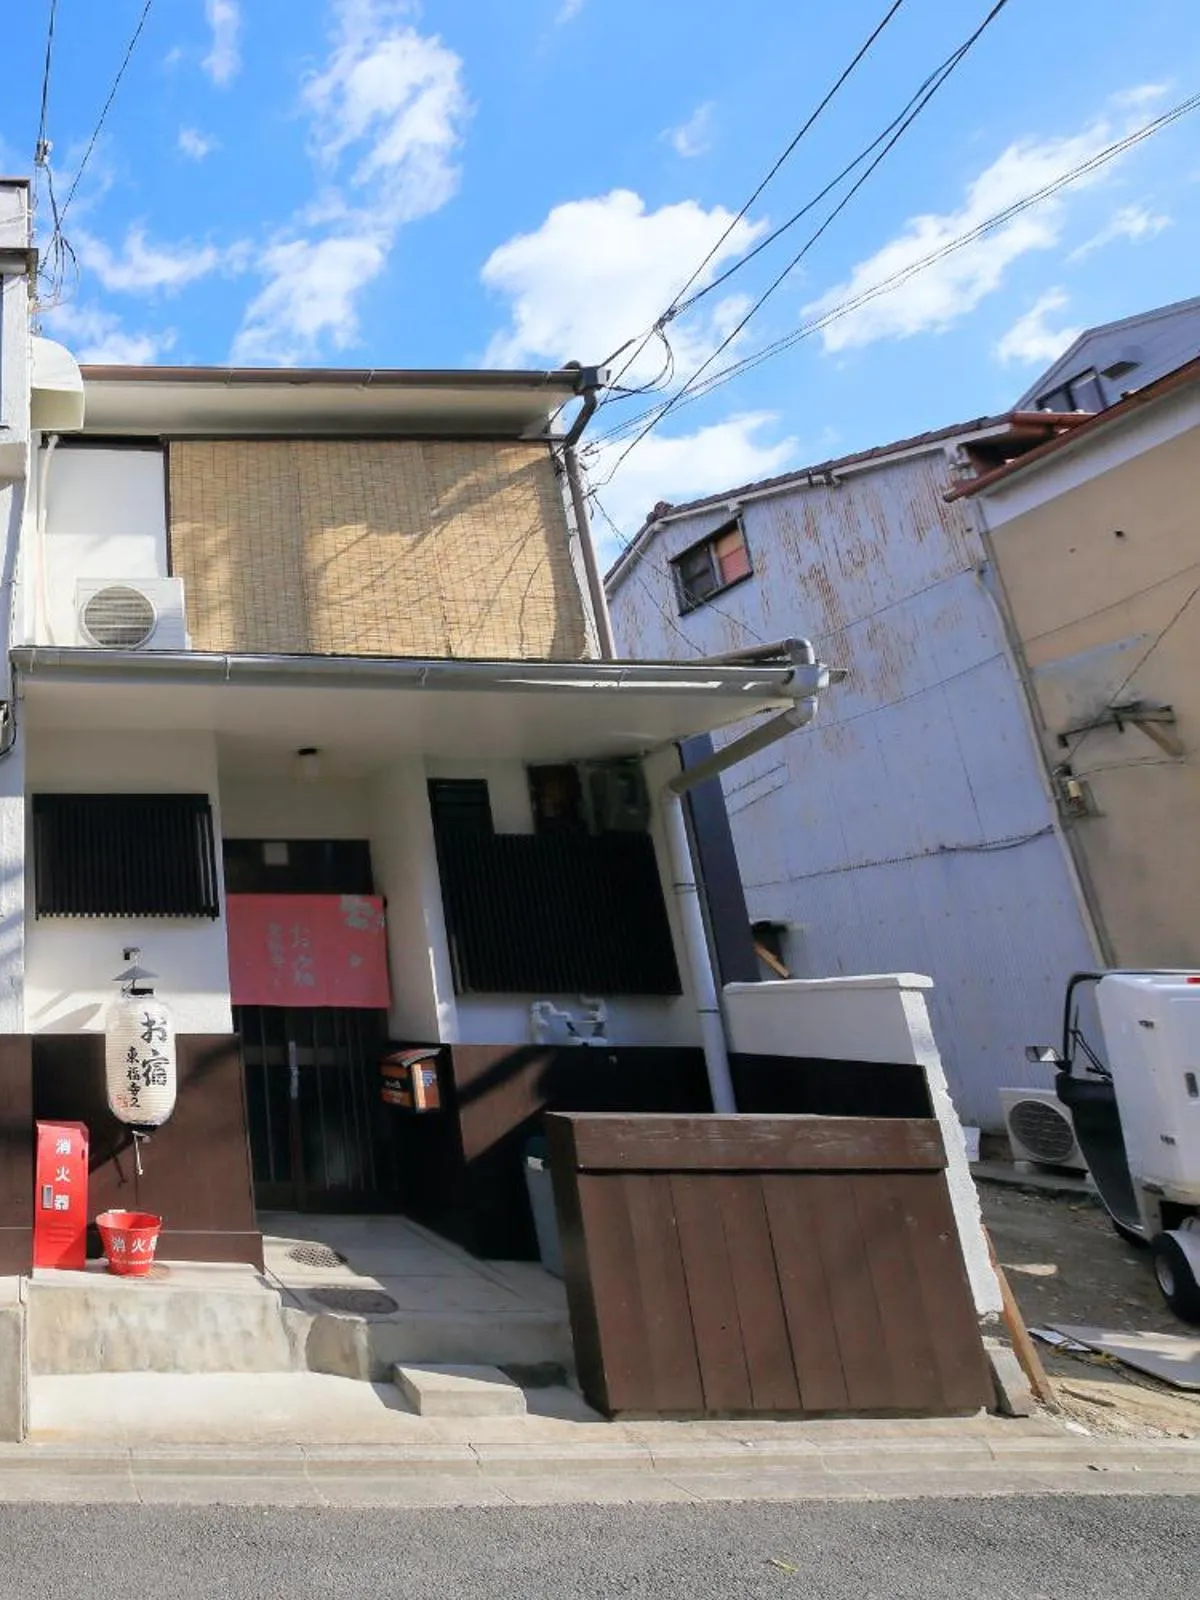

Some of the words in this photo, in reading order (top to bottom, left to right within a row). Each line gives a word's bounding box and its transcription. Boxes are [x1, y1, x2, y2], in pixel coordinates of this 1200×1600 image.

[141, 1012, 170, 1087] お宿
[54, 1136, 71, 1210] 消火器
